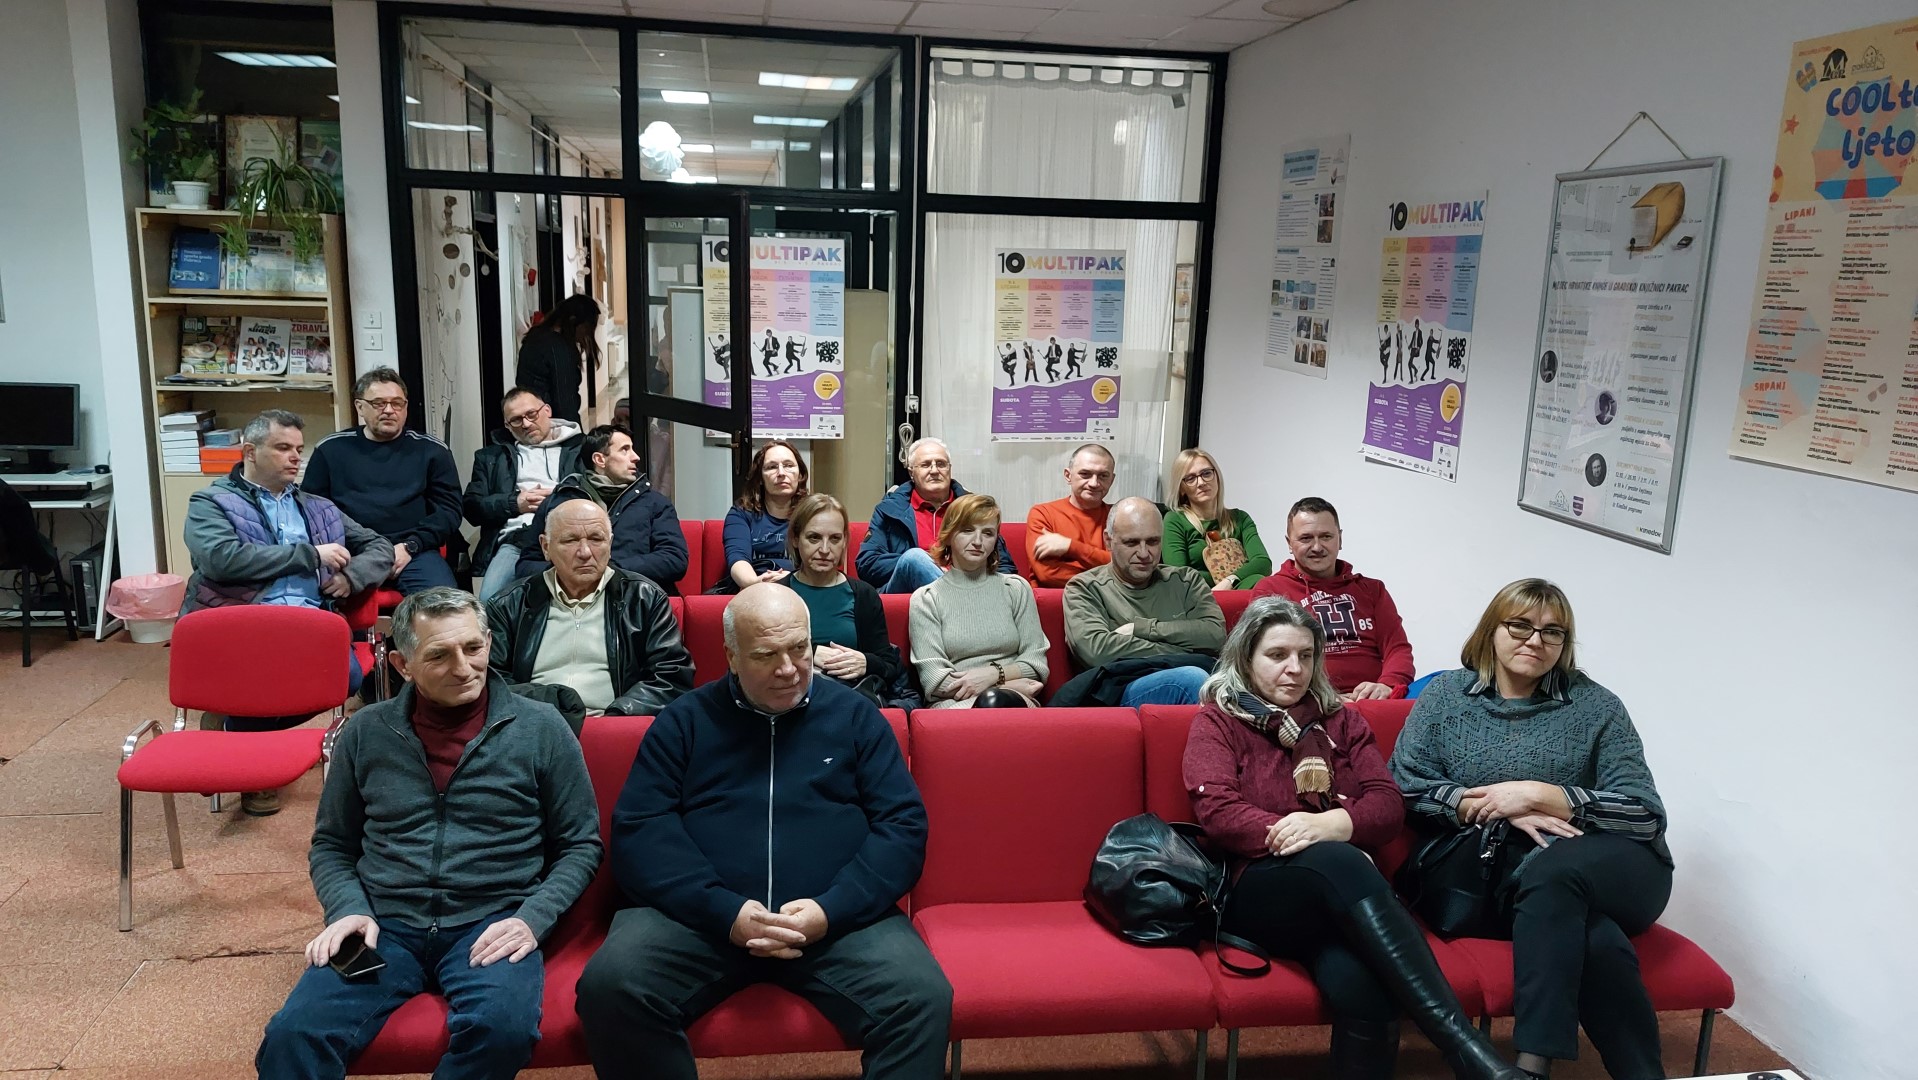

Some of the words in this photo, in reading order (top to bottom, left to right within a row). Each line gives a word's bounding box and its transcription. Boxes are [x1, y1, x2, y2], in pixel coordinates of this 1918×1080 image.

[1841, 125, 1916, 170] ljeto
[1389, 201, 1408, 232] 10
[1407, 200, 1486, 225] MULTIPAK
[1785, 206, 1815, 221] LIPANJ
[704, 240, 730, 263] 10
[750, 245, 842, 262] ULTIPAK
[997, 252, 1025, 273] 10
[1026, 255, 1124, 271] MULTIPAK
[1665, 283, 1690, 293] PAKRAC
[291, 323, 329, 333] ZDRAVLJ
[1754, 381, 1786, 391] SRPANJ
[1312, 600, 1362, 644] H
